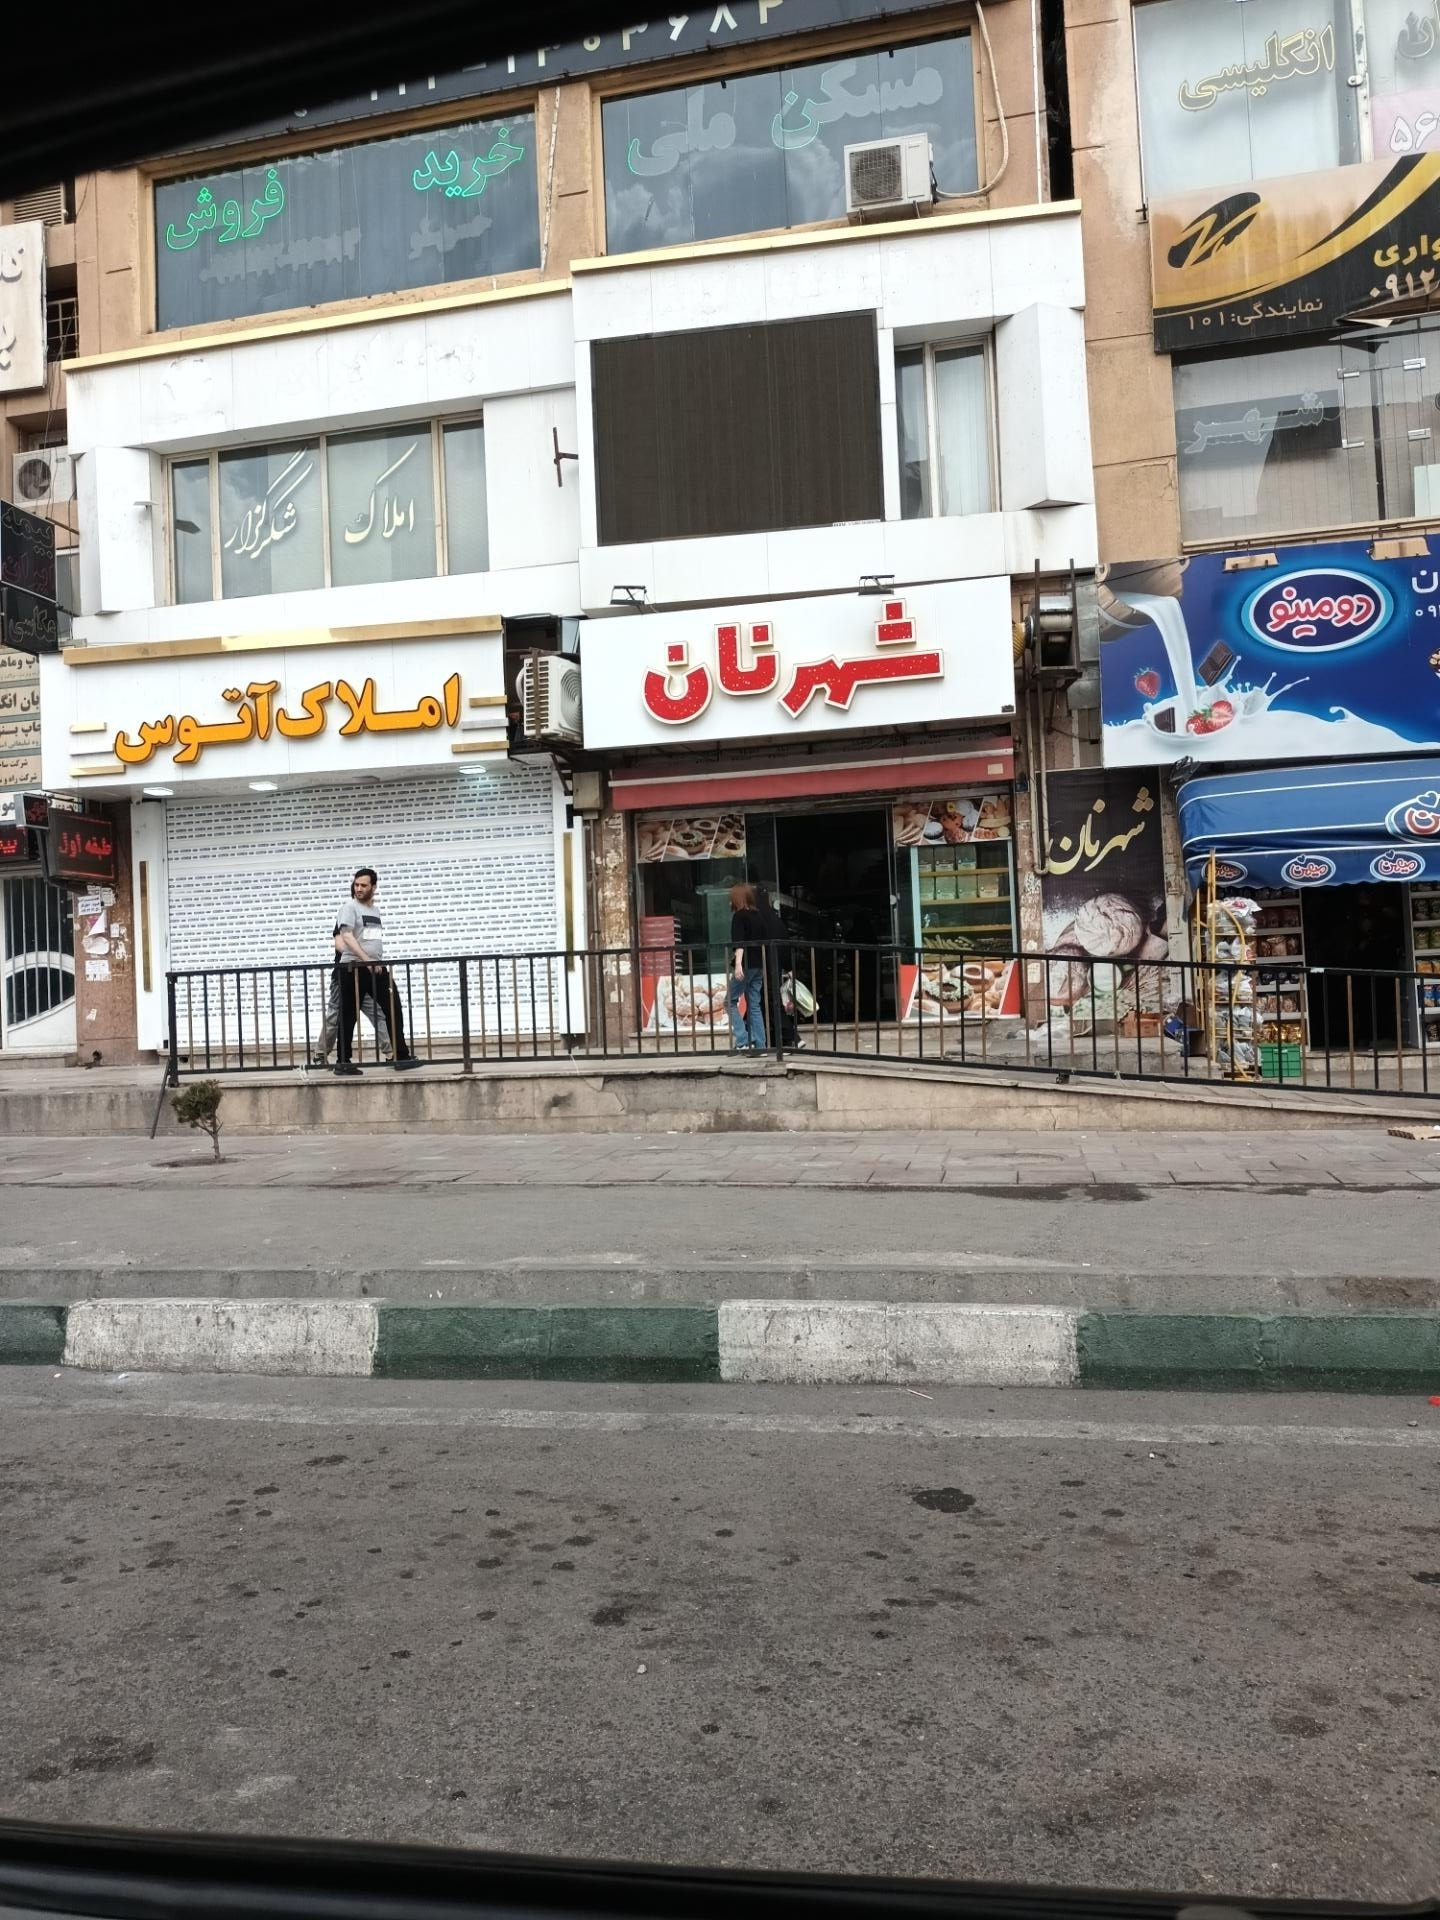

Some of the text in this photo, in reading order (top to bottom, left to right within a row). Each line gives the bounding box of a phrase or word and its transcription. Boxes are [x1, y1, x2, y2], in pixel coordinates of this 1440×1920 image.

[1178, 22, 1336, 112] انگلیسی
[627, 57, 944, 177] مسکن ملی
[1390, 111, 1440, 152] ۵۶
[166, 127, 525, 250] خرید فروش
[344, 441, 418, 544] املاک
[1266, 586, 1375, 640] دومینو
[114, 672, 465, 765] املاک آتوس
[84, 836, 113, 861] طبقه
